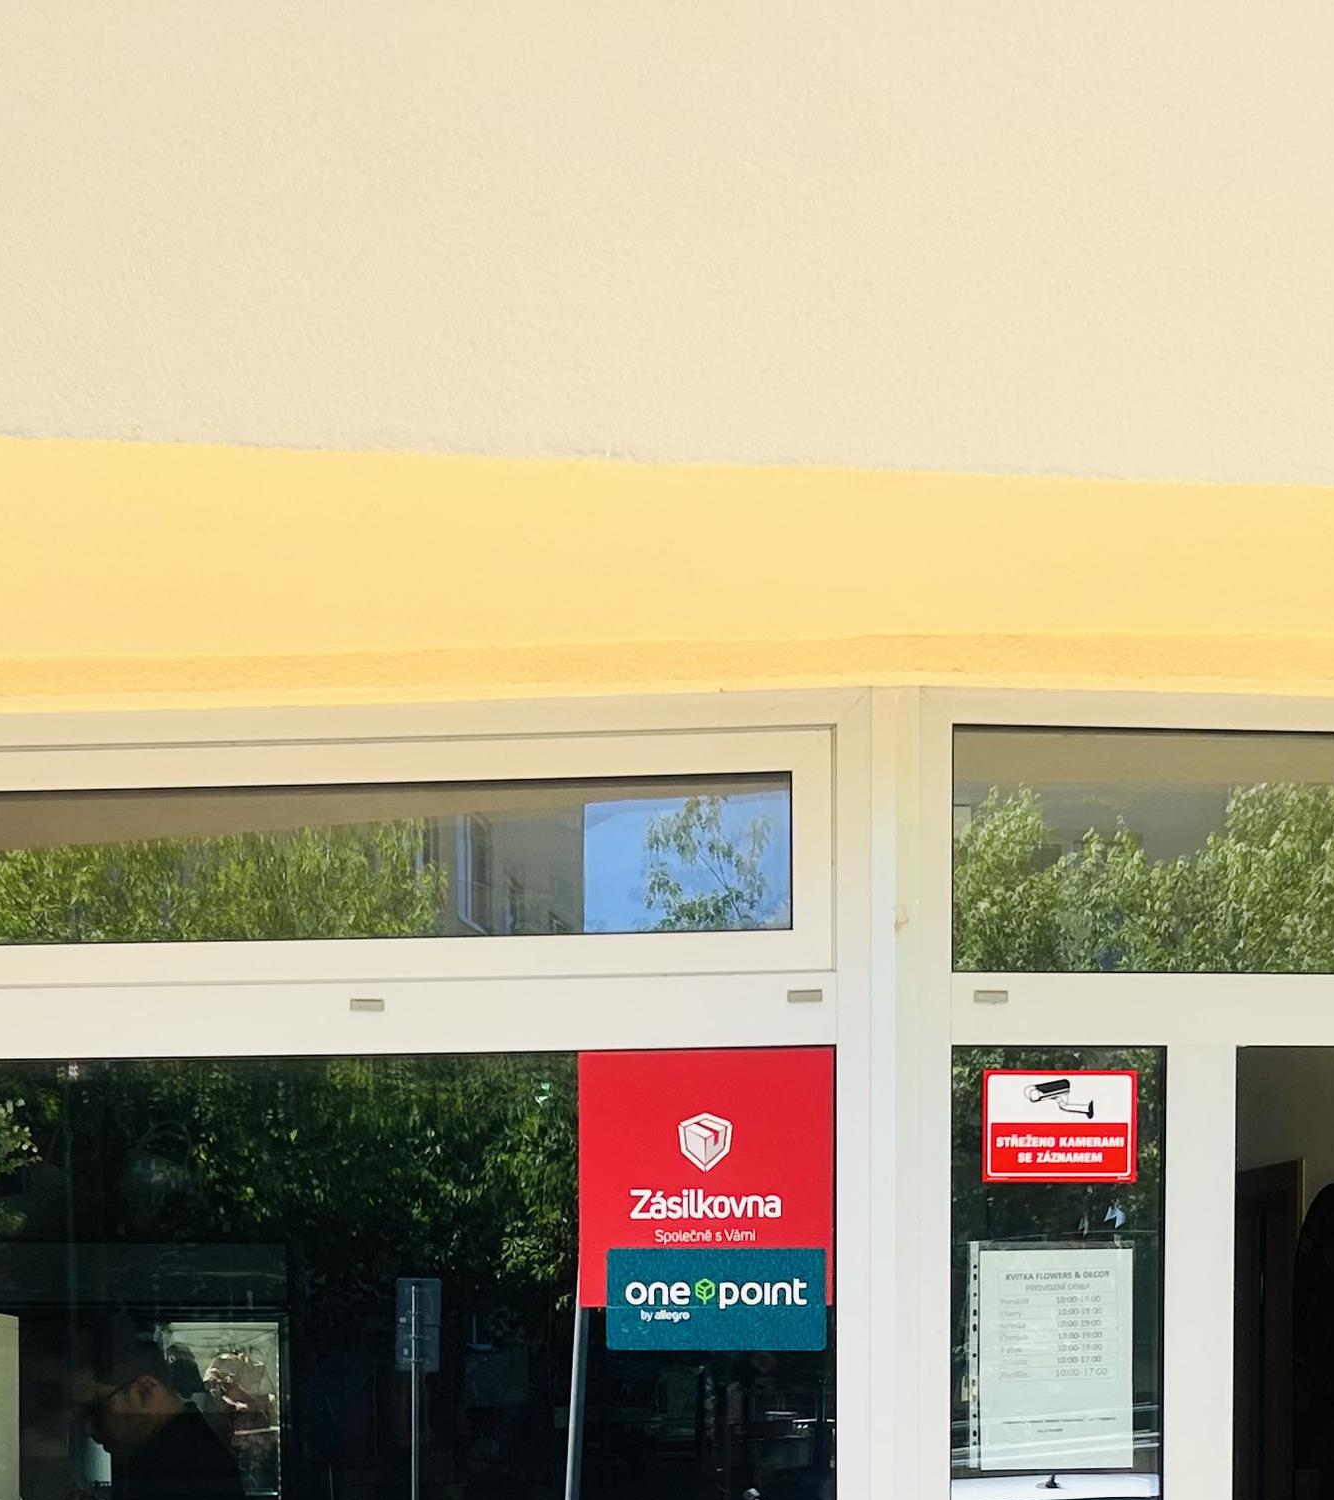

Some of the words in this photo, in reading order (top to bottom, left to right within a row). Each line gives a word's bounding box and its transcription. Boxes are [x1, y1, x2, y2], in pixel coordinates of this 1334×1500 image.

[995, 1134, 1056, 1148] STŘEŽENO
[1058, 1136, 1125, 1148] KAMERAMI
[1017, 1152, 1033, 1164] SE
[1036, 1149, 1103, 1164] ZÁZNAMEM
[629, 1188, 782, 1220] Zásilkovna
[654, 1228, 712, 1245] Společně
[715, 1230, 722, 1242] s
[724, 1228, 757, 1242] Vámi
[624, 1281, 691, 1306] one
[719, 1278, 808, 1309] point
[641, 1310, 653, 1321] by
[654, 1310, 691, 1322] allegro
